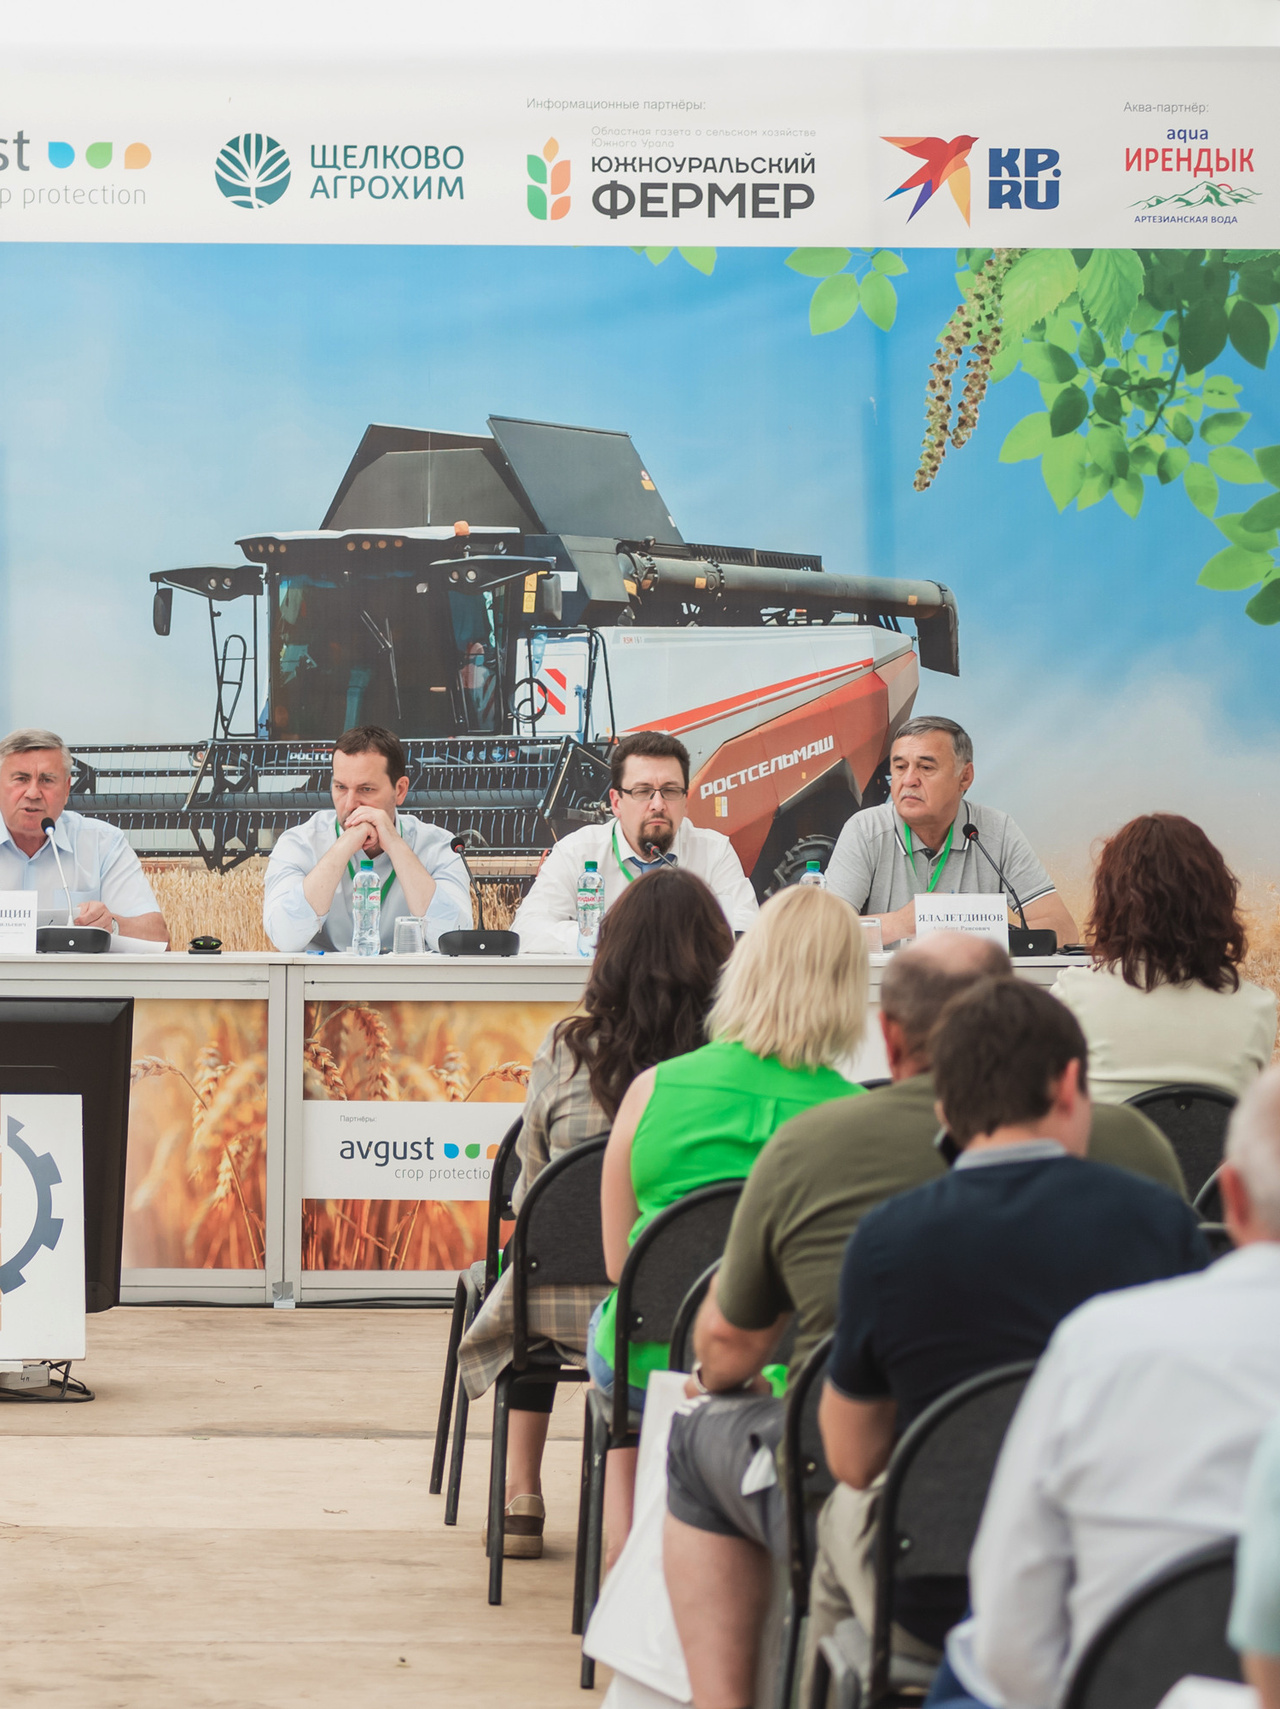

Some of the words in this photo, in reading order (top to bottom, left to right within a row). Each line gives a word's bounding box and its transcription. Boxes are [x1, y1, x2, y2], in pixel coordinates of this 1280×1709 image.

[527, 98, 639, 111] Информационные
[644, 99, 705, 112] партнёры:
[1123, 102, 1208, 115] Аква-партнёр:
[591, 126, 651, 135] Областная
[762, 128, 816, 137] хозяйстве
[1167, 129, 1208, 143] aqua
[592, 136, 637, 147] Южного
[641, 139, 674, 149] Урала
[311, 145, 464, 170] ЩЕЛКОВО
[592, 153, 815, 174] ЮЖНОУРАЛЬСКИЙ
[989, 148, 1061, 178] KP.
[1126, 148, 1254, 178] ИРЕНДЫК
[310, 175, 464, 199] АГРОХИМ
[988, 180, 1059, 210] RU
[23, 184, 145, 209] protection
[592, 180, 814, 219] ФЕРМЕР
[1211, 216, 1238, 224] ВОДА
[290, 752, 333, 761] РОСТС
[700, 735, 834, 799] РОСТСЕЛЬМАШ
[918, 914, 1004, 922] ЯЛАЛЕТДИНОВ
[340, 1115, 375, 1123] Партнёры:
[340, 1137, 434, 1167] avgust
[395, 1169, 423, 1181] crop
[429, 1167, 491, 1182] protectio
